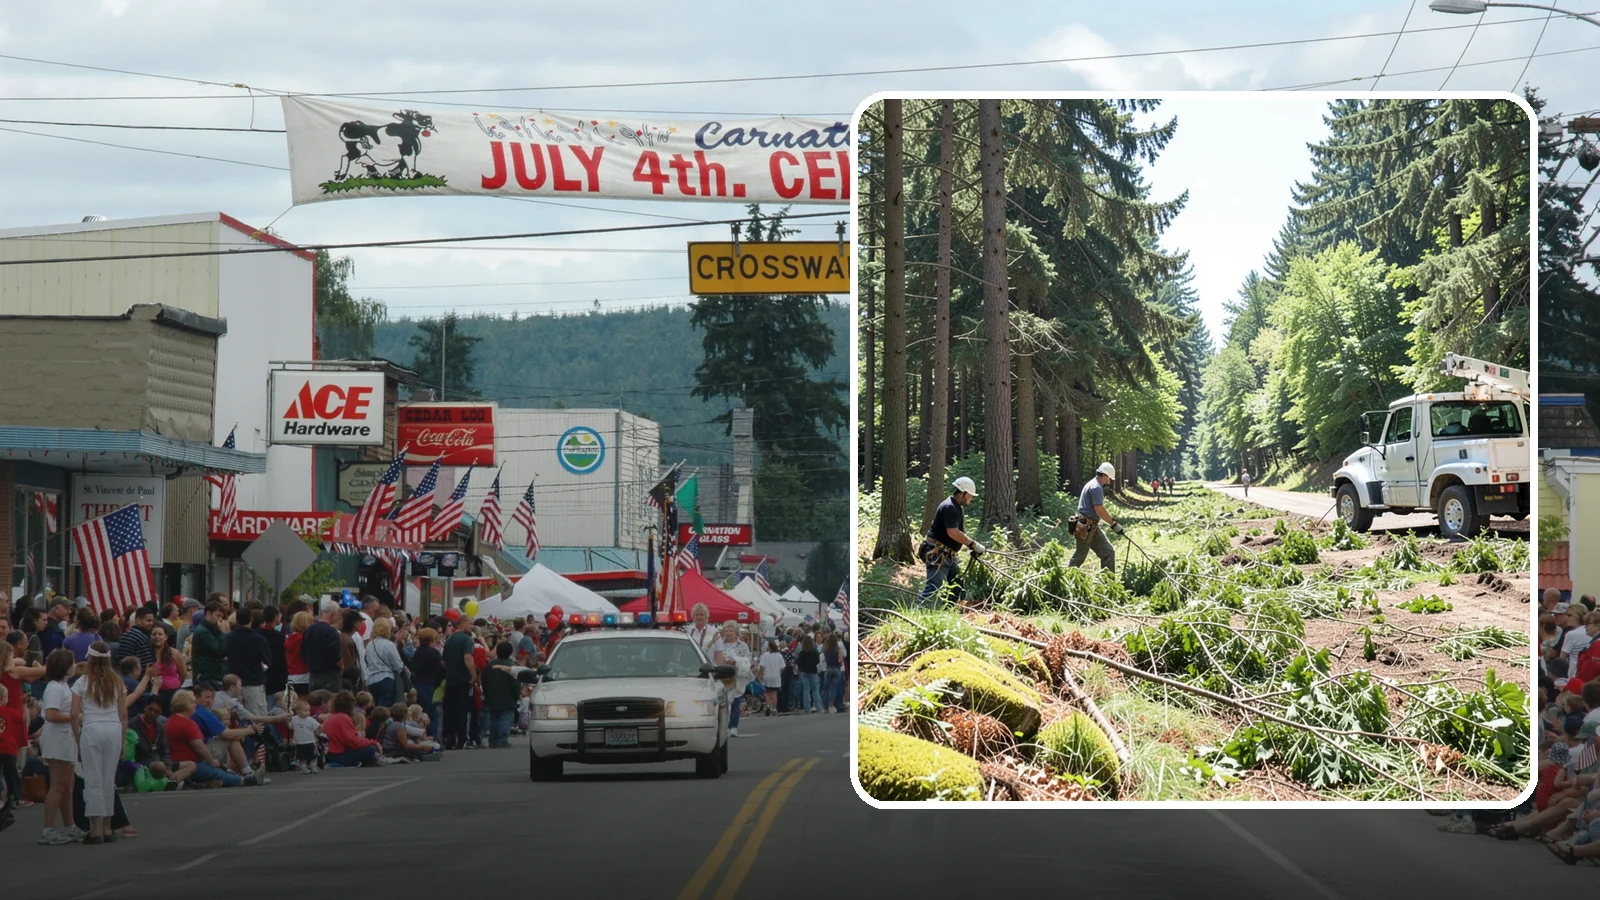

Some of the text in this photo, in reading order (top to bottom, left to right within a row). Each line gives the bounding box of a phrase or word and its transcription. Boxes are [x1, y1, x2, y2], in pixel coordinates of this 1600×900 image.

[481, 141, 604, 192] JULY
[632, 151, 746, 198] 4th.
[697, 254, 850, 280] CROSSWA
[283, 380, 374, 419] ACE
[405, 409, 485, 422] CEDAR LOG
[283, 421, 371, 436] Hardware
[353, 467, 385, 480] Simpl
[95, 485, 124, 494] Vincent
[126, 485, 135, 494] de
[137, 485, 155, 495] Paul
[688, 527, 741, 535] CRNATION
